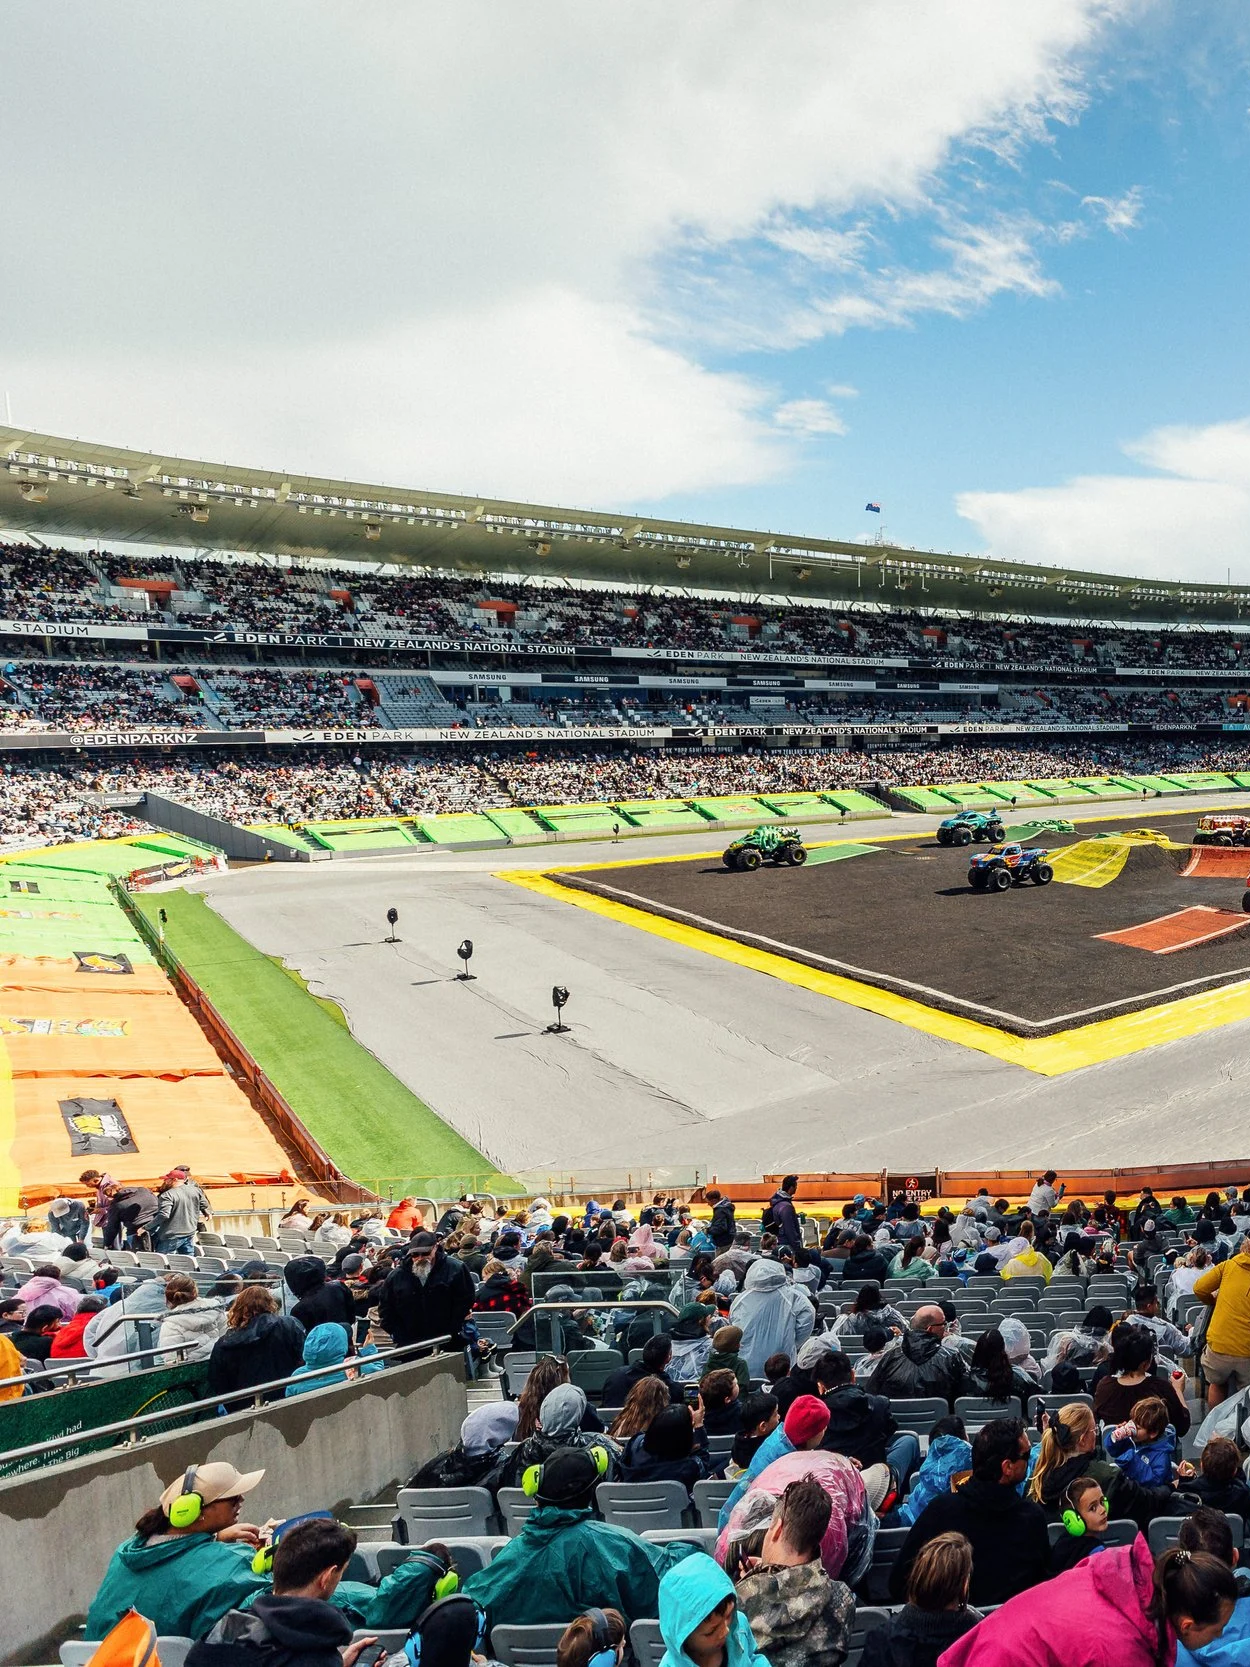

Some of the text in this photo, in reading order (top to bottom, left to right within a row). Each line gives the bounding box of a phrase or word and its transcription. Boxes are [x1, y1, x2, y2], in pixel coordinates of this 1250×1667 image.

[12, 623, 89, 636] STADIUM
[234, 633, 576, 655] EDEN PARK NEW ZEALAND'S NATIONAL STADIUM
[666, 651, 694, 659] EDEN
[698, 652, 724, 660] PARK
[762, 654, 809, 664] ZEALAND'S
[812, 656, 850, 665] NATIONAL
[852, 658, 885, 666] STADIUM
[1010, 664, 1044, 672] ZEALAND'S
[468, 673, 507, 681] SAMSUNG
[574, 675, 609, 683] SAMSUNG
[323, 729, 656, 741] EDEN PARK NEW ZEALAND'S NATIONAL STADIUM
[708, 728, 736, 736] EDEN
[739, 728, 767, 736] PARK
[806, 727, 852, 735] ZEALAND'S
[853, 726, 893, 734] NATIONAL
[894, 726, 928, 734] STADIUM
[69, 733, 198, 746] @EDENPARKNZ
[906, 1189, 932, 1197] ENTRY
[66, 1420, 82, 1435] had
[65, 1447, 80, 1460] Big
